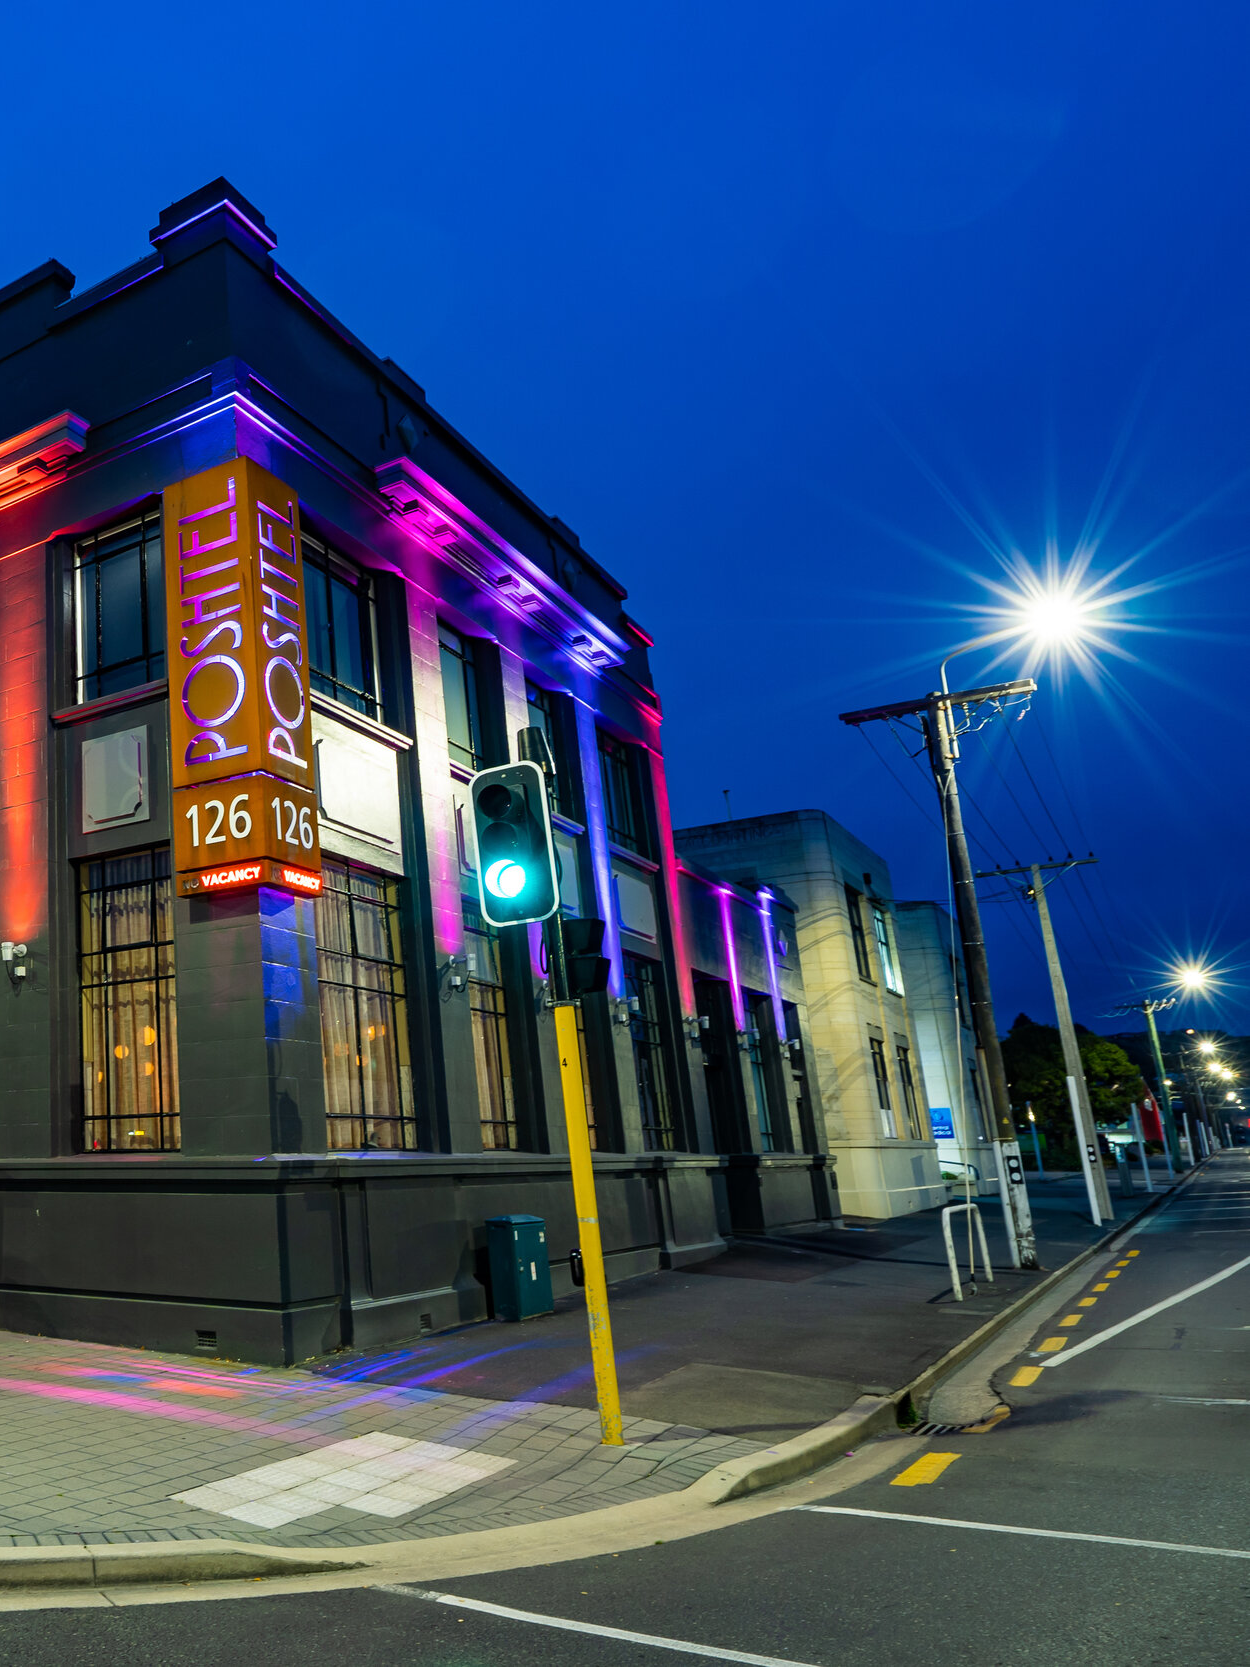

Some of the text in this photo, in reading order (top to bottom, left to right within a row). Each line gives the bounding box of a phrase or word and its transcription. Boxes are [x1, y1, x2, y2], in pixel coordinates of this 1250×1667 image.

[178, 476, 248, 767] POSHTEL
[256, 501, 308, 768] POSHTEL
[185, 794, 252, 847] 126
[271, 796, 314, 850] 126
[201, 866, 261, 887] VACANCY
[283, 870, 321, 890] VACANCY
[562, 1057, 568, 1068] 4
